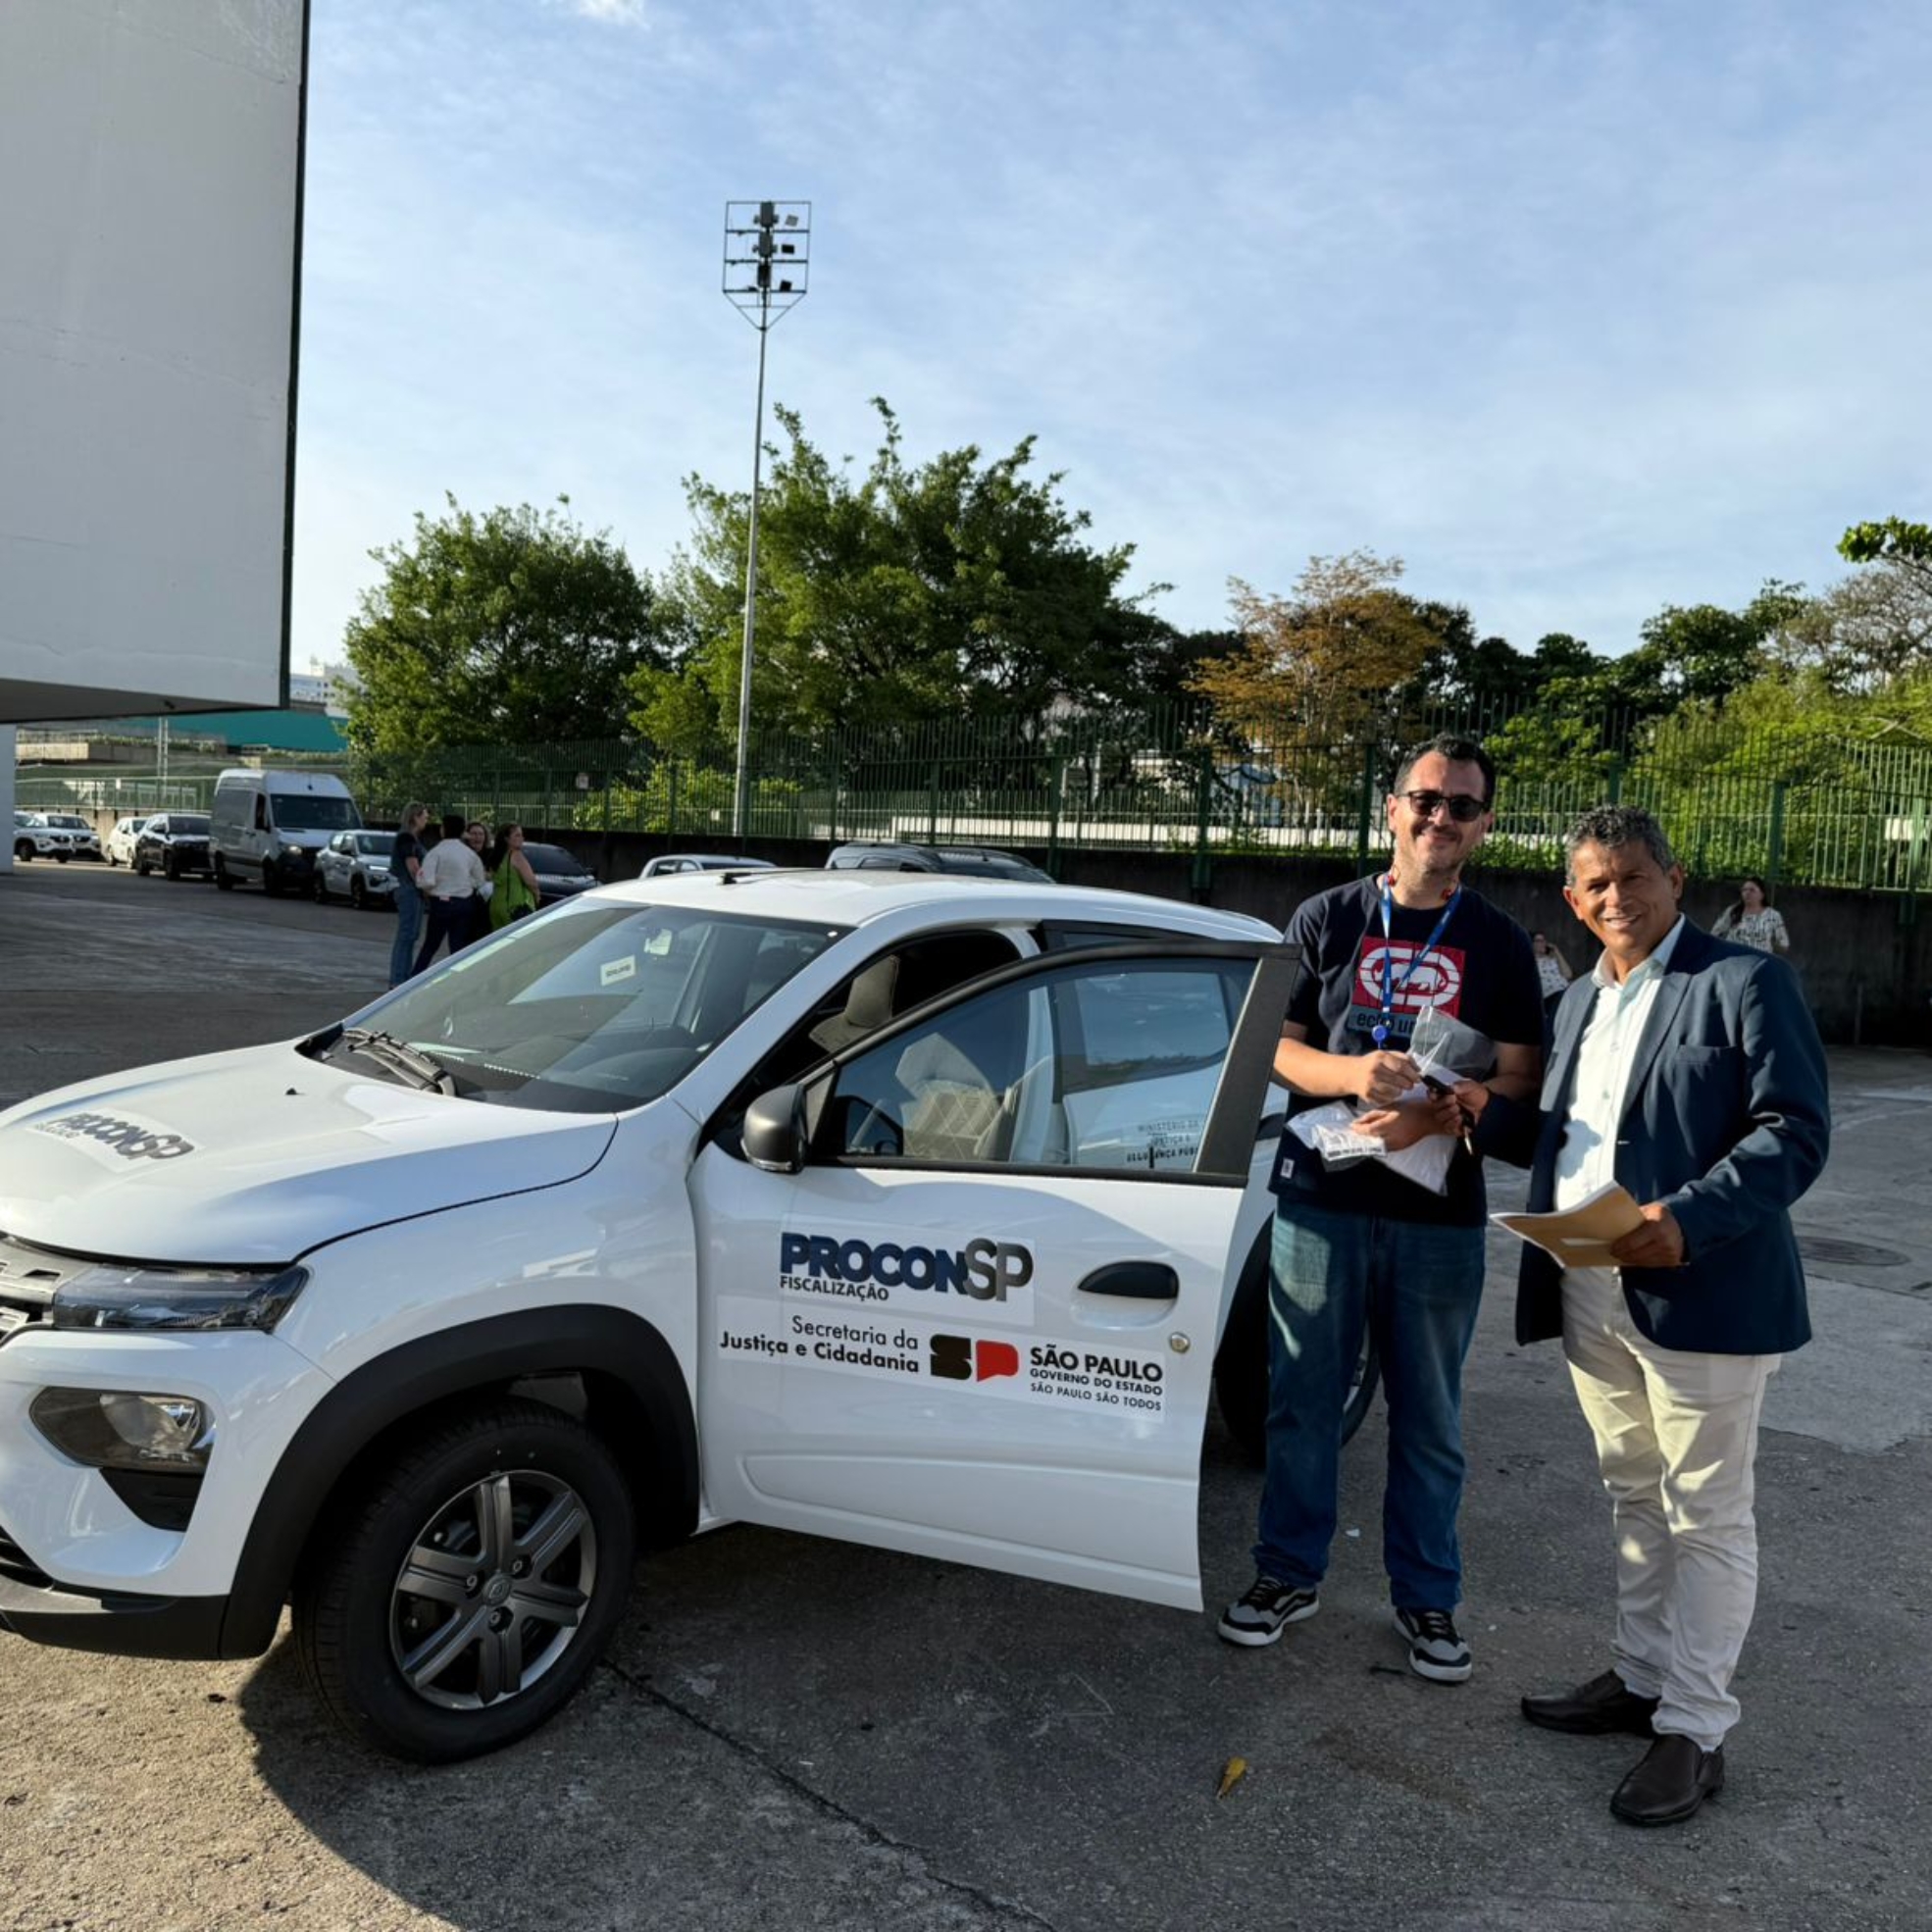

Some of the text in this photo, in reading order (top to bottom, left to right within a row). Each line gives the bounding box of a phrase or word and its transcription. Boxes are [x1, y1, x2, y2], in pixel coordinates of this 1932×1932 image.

[780, 1275, 890, 1301] FISCALIZAÇÃO
[791, 1314, 918, 1349] Secretaria da
[719, 1331, 919, 1373] Justiça e Cidadania
[1030, 1344, 1163, 1383] SÃO PAULO
[1030, 1367, 1163, 1397] GOVERNO DO ESTADO
[1031, 1381, 1162, 1411] SÃO PAULO SÃO TODOS
